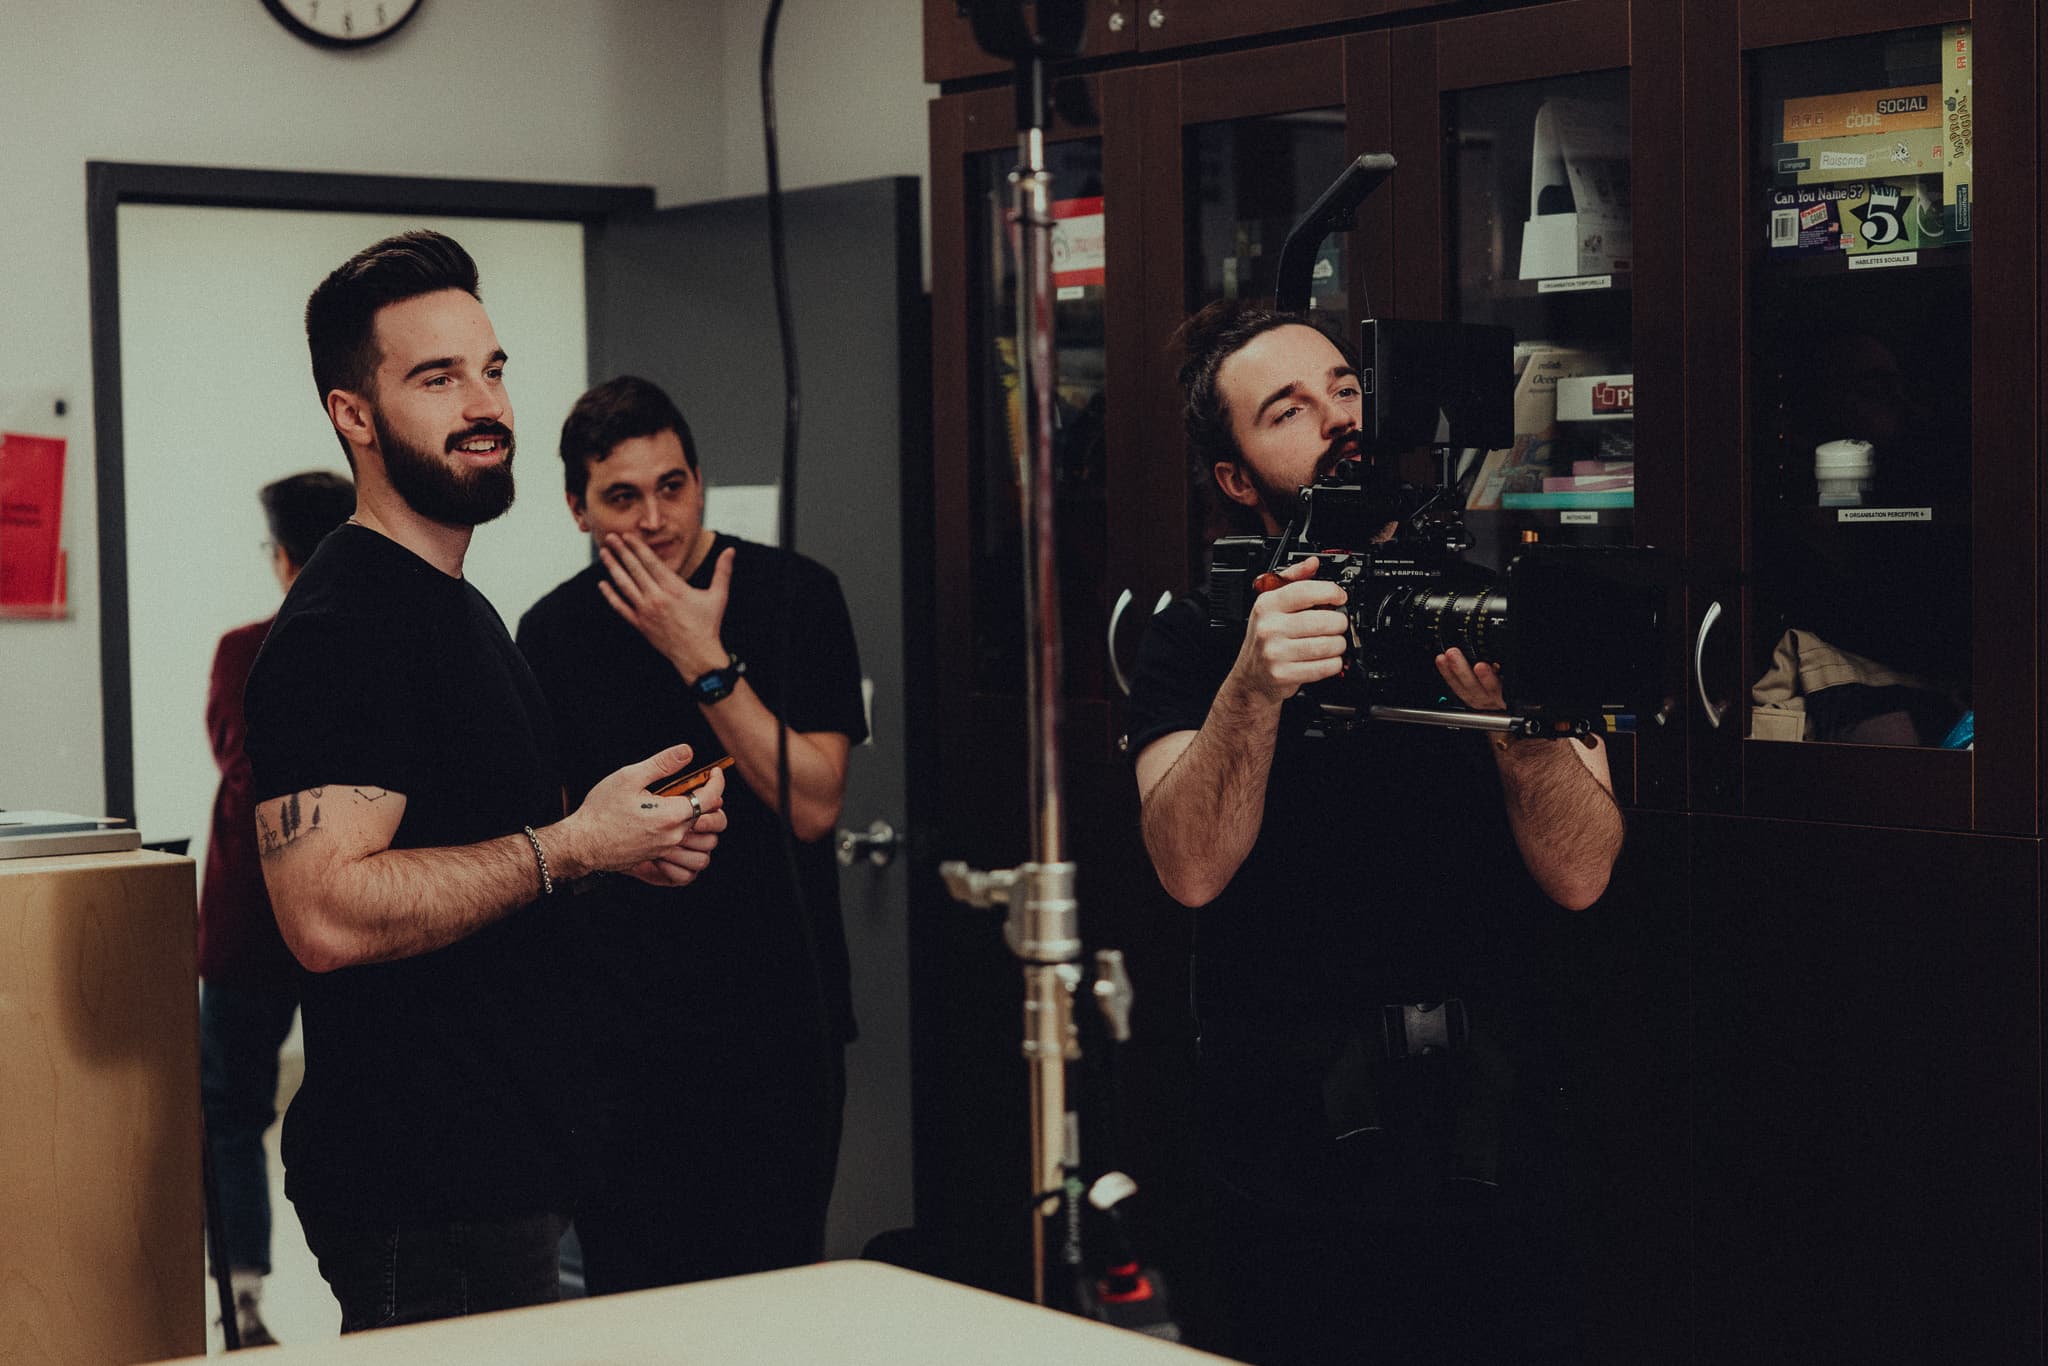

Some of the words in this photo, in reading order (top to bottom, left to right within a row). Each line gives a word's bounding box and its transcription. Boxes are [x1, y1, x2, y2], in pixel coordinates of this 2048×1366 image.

[1878, 97, 1927, 113] SOCIAL
[1845, 113, 1881, 129] CODE
[1774, 191, 1795, 205] Can
[1797, 190, 1816, 203] You
[1817, 187, 1847, 201] Name
[1849, 184, 1864, 200] 5?
[1861, 194, 1900, 243] 5
[1884, 255, 1910, 263] SOCIALES
